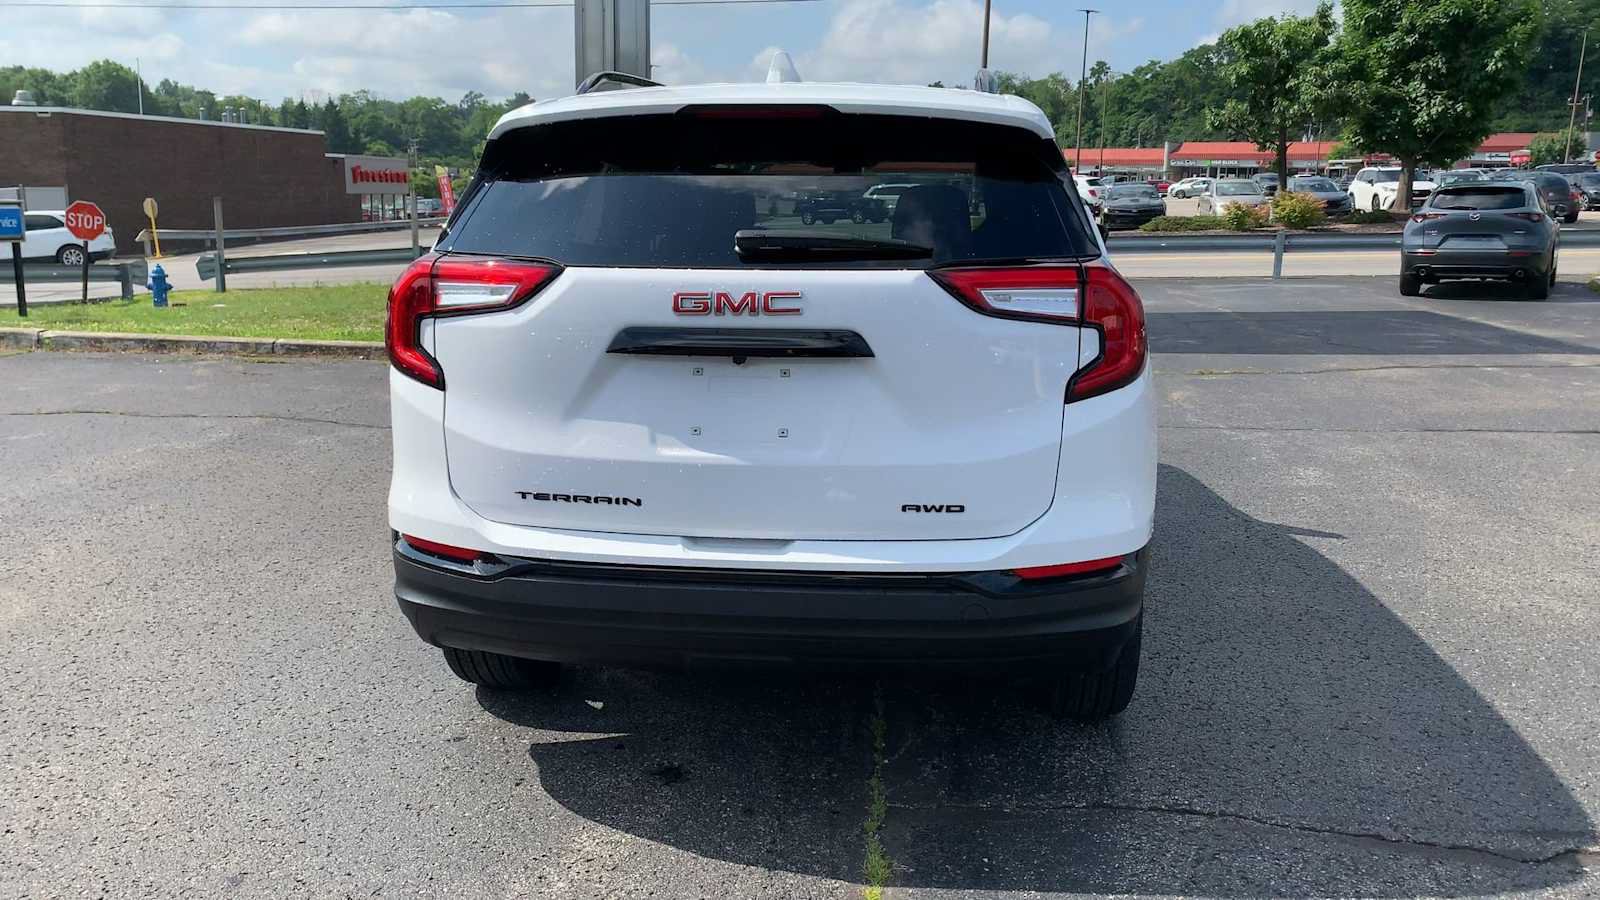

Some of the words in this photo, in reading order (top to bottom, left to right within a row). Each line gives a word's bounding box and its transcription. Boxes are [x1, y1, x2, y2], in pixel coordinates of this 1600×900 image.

[67, 212, 103, 230] STOP
[672, 291, 803, 316] GMC
[514, 491, 643, 507] TERRAIN
[901, 504, 965, 513] AWD
